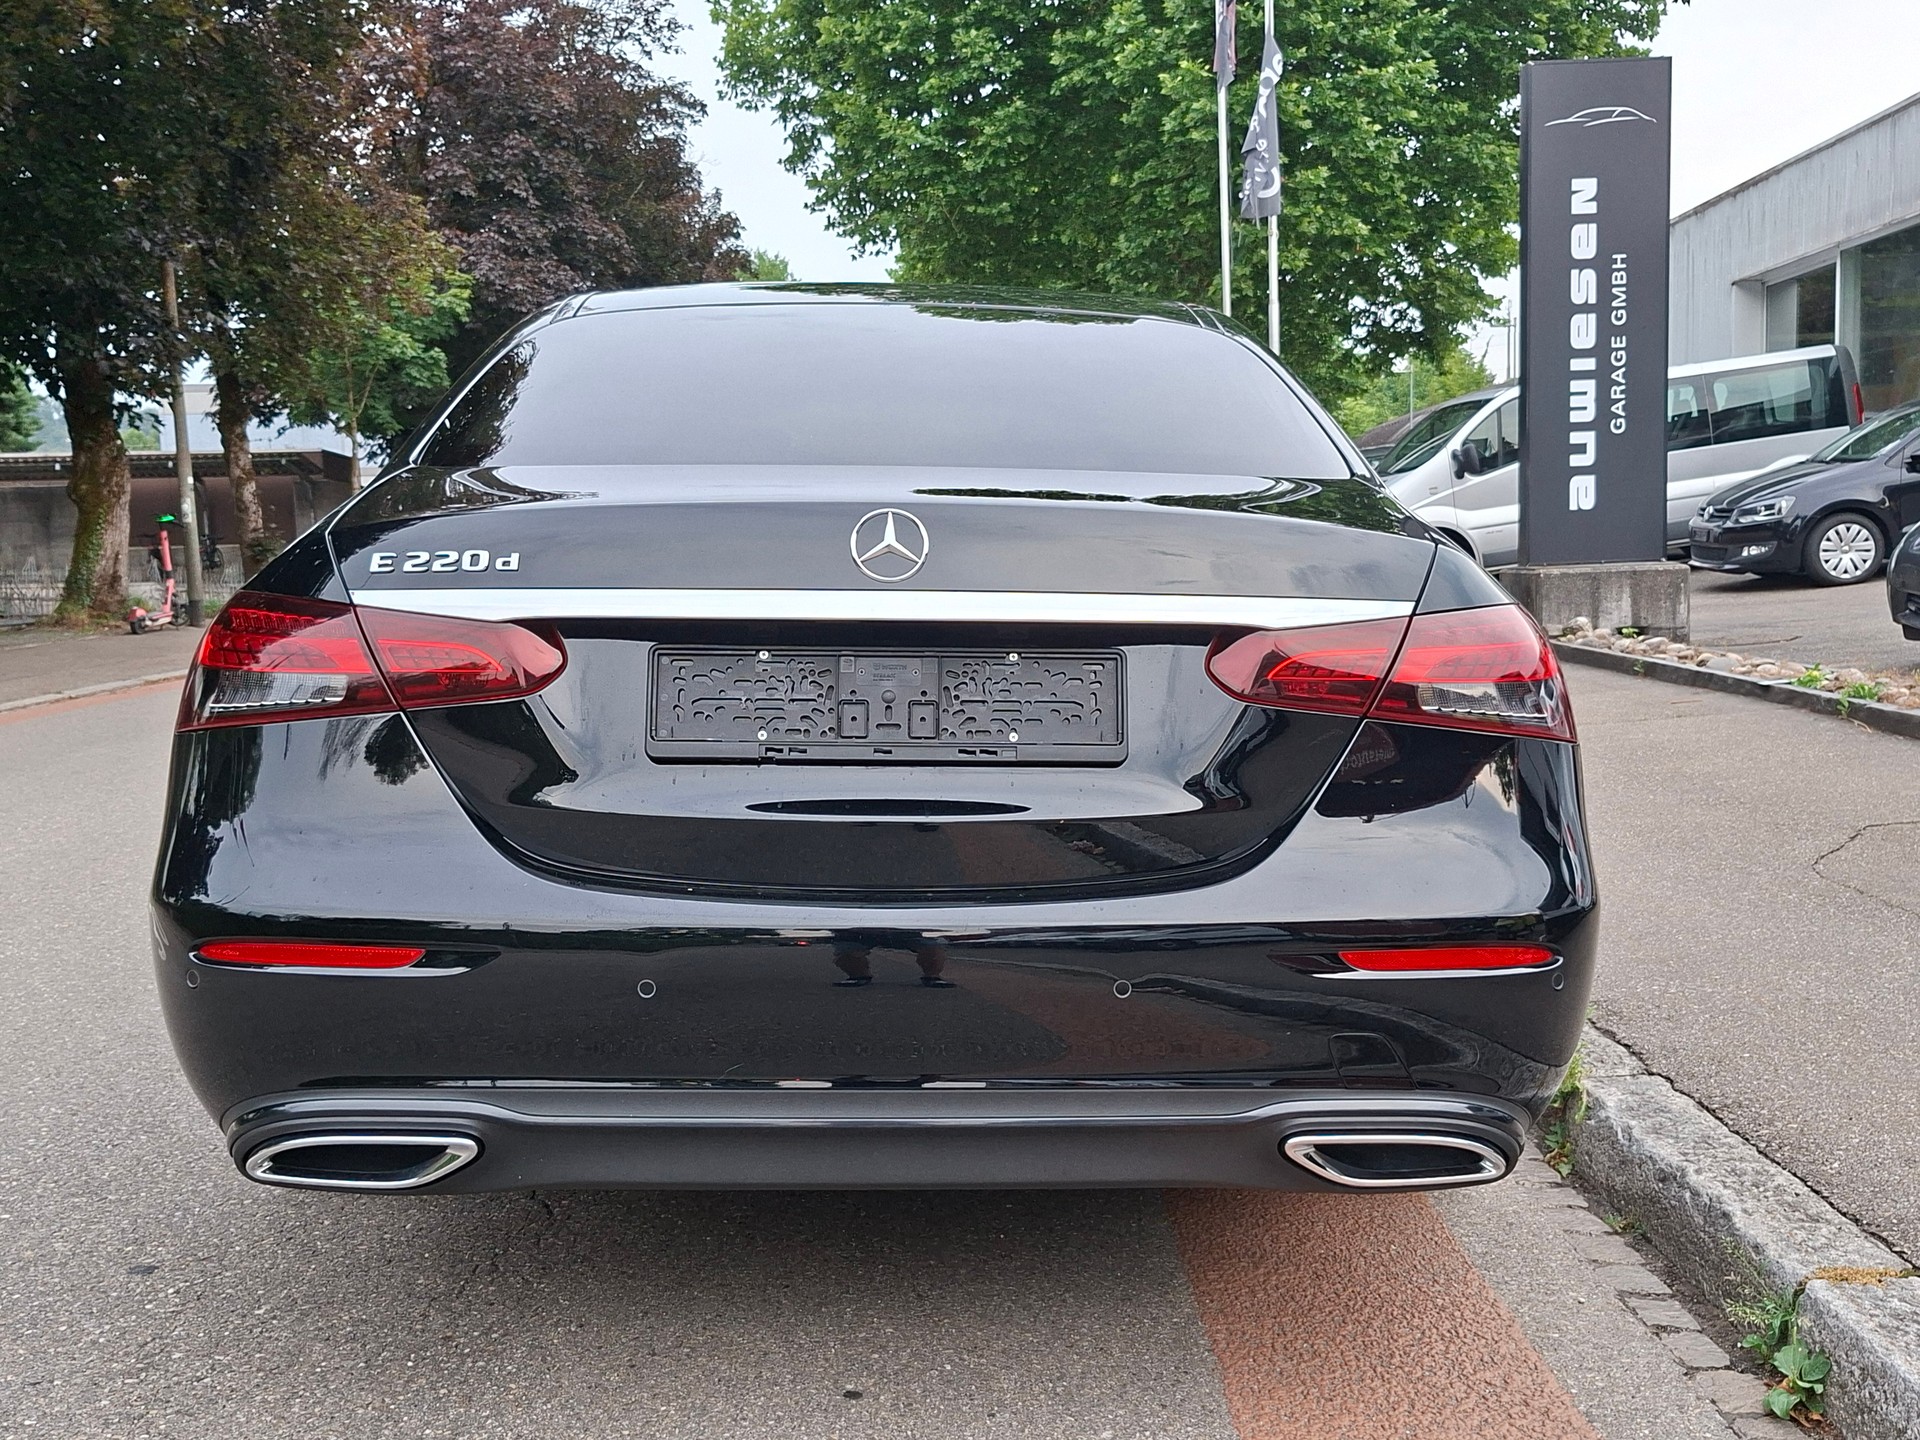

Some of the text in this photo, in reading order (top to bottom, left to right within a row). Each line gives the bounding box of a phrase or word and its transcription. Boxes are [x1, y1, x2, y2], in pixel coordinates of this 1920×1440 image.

[1610, 253, 1628, 435] GARAGE GMBH
[369, 552, 398, 573] E
